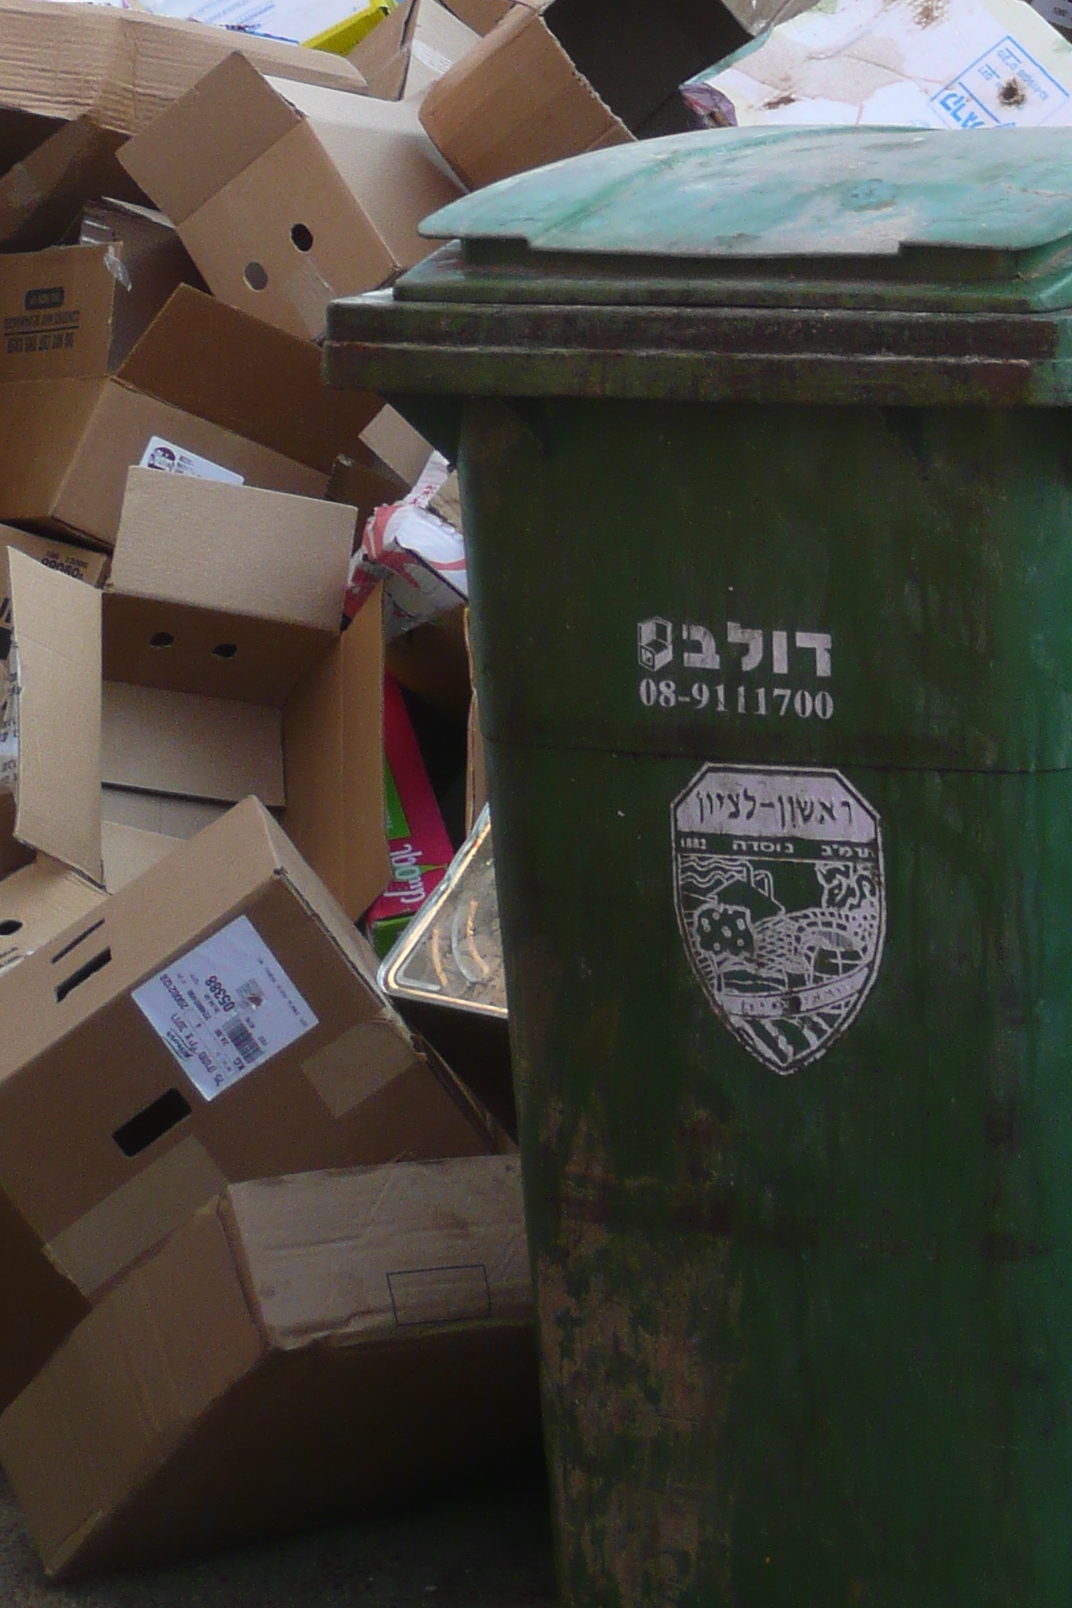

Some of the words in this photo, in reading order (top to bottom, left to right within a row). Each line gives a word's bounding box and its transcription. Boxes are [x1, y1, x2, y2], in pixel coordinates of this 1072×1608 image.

[682, 622, 833, 677] דולב
[638, 678, 835, 720] 08-9111700
[679, 837, 708, 851] 1882
[732, 838, 795, 854] נוסדה
[204, 974, 236, 1013] 05388
